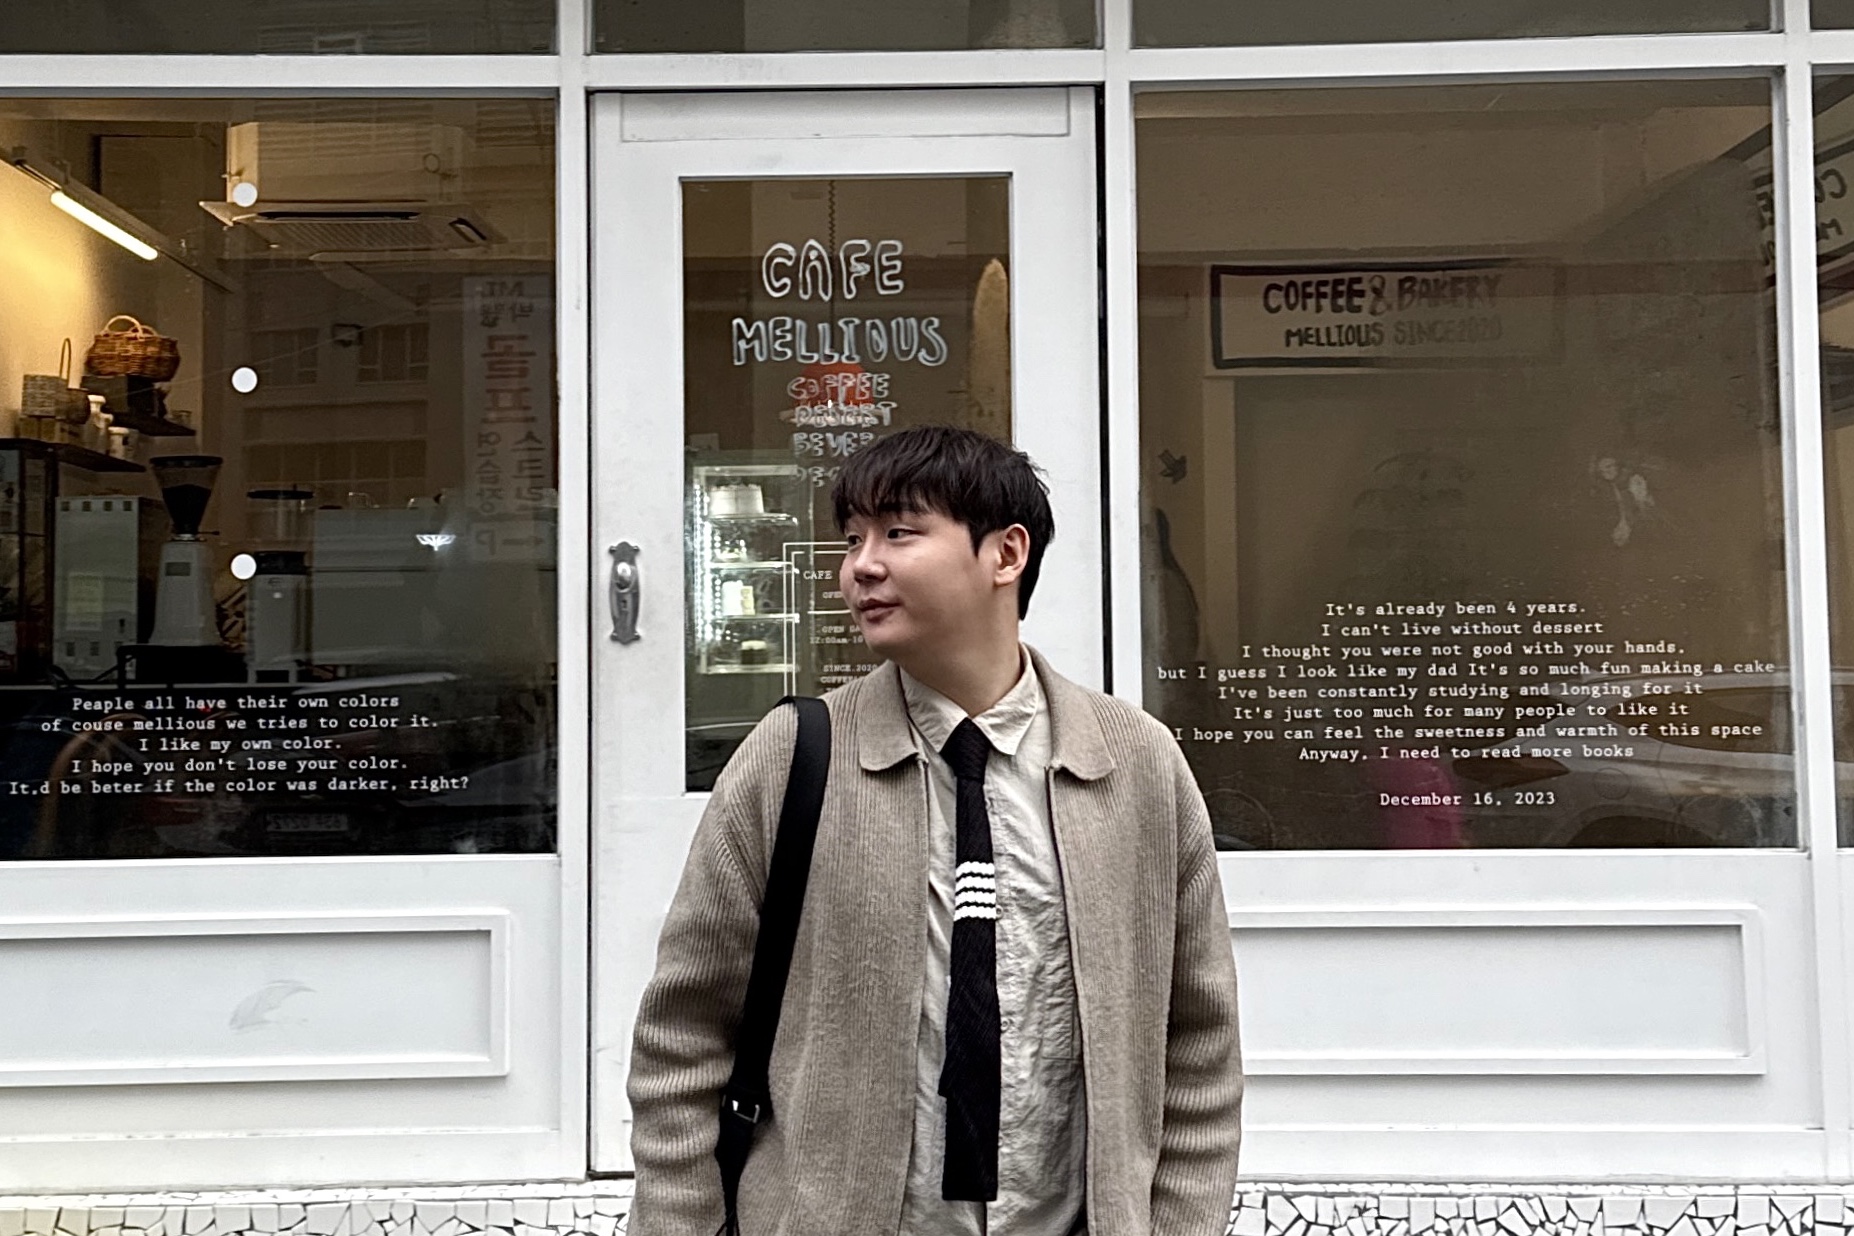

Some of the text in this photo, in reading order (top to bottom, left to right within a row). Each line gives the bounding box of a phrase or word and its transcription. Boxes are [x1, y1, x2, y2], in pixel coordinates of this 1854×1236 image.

[762, 238, 904, 301] CAFE
[1263, 277, 1366, 314] COFFEE
[1397, 275, 1502, 311] BAKERY
[732, 317, 948, 366] MELLIOUS
[1285, 322, 1384, 347] MELLIOUS
[787, 372, 890, 402] COFFEE
[803, 570, 833, 580] CAFE
[1326, 600, 1587, 618] It's already been 4 years.
[1321, 620, 1604, 637] I can't live without dessert
[1242, 639, 1685, 661] I thought you were not good with your hands.
[1157, 659, 1776, 683] but I guess I look like my dad It's so much fun making a cake
[1218, 681, 1704, 701] I've been constantly studying and longing for it
[72, 693, 399, 714] Peaple all have their own colors
[1234, 701, 1689, 723] It's just too much for many people to like it
[40, 714, 438, 732] of couse mellious we tries to color it.
[1173, 722, 1762, 744] I hope you can feel the sweetness and warmth of this space
[139, 735, 341, 754] I like my own color.
[1380, 746, 1389, 759] I
[1399, 745, 1440, 759] need
[1450, 747, 1471, 759] to
[1481, 744, 1522, 759] read
[1530, 747, 1572, 758] more
[1581, 743, 1634, 758] books
[71, 755, 407, 776] I hope you don't lose your color.
[60, 780, 82, 794] be
[90, 779, 143, 794] beter
[153, 778, 175, 793] if
[184, 778, 215, 793] the
[225, 777, 277, 792] color
[286, 780, 317, 791] was
[409, 775, 469, 793] right?
[1379, 791, 1462, 806] December
[1514, 791, 1555, 805] 2023
